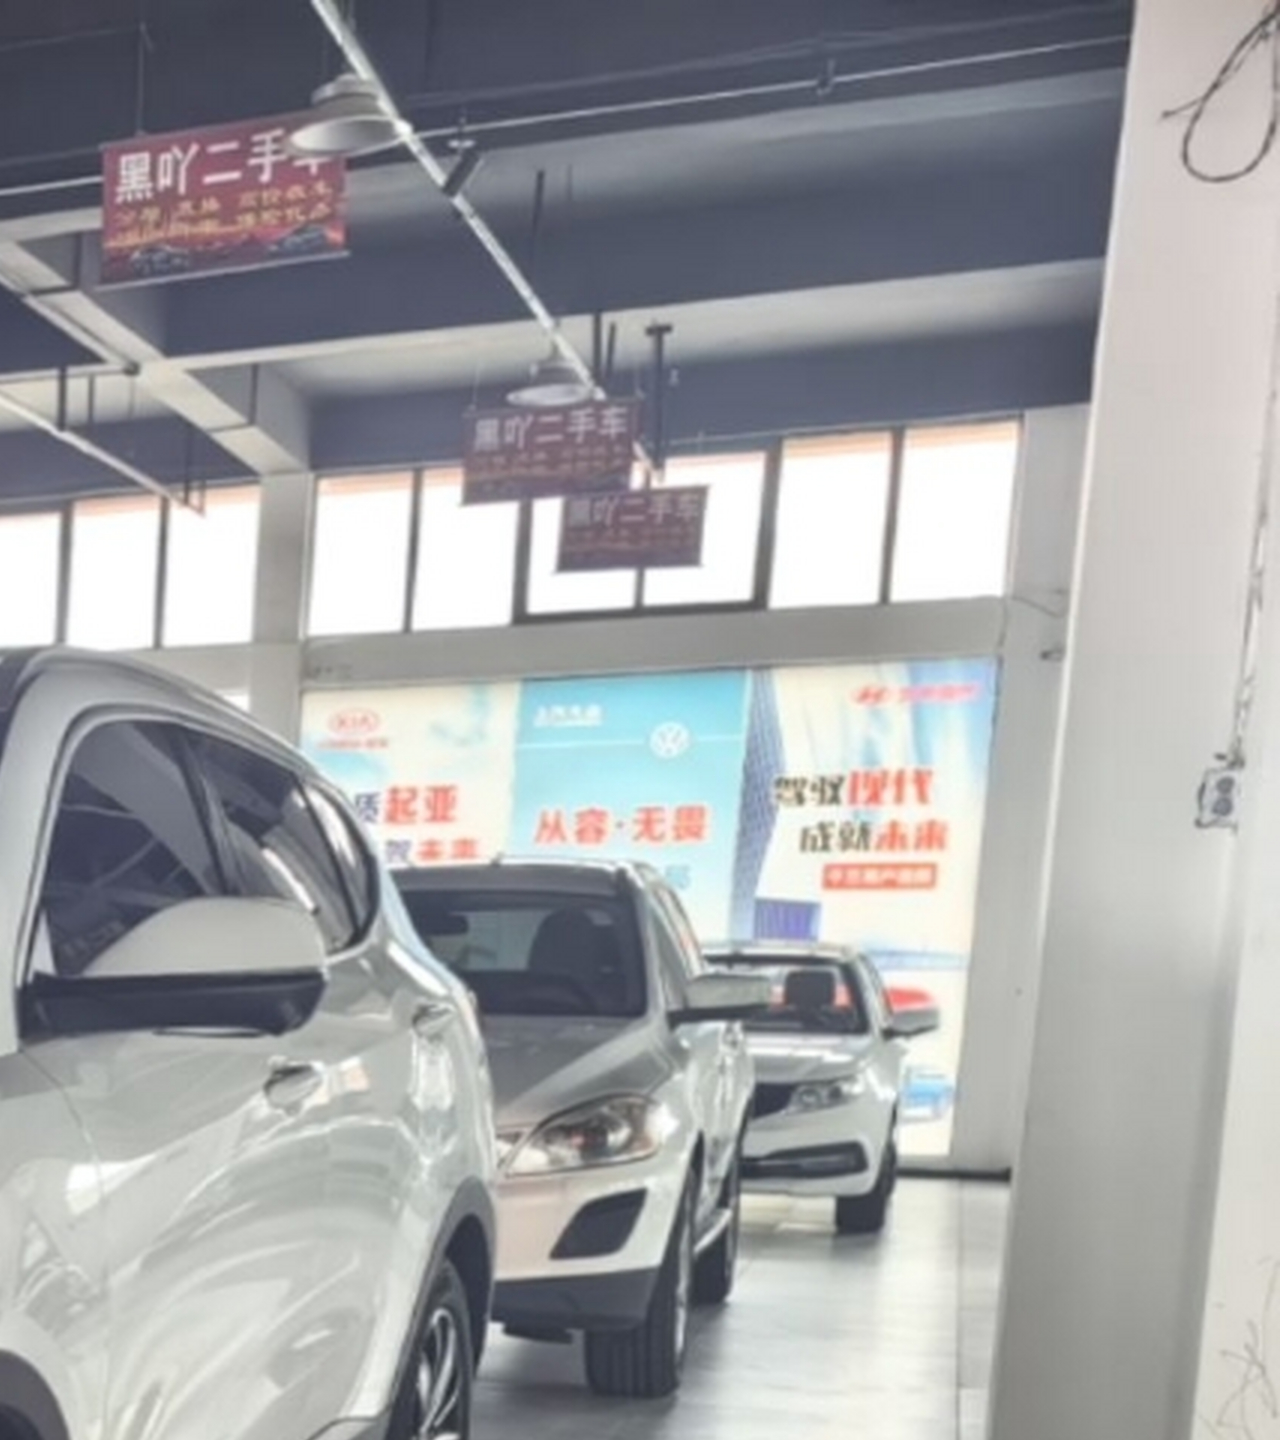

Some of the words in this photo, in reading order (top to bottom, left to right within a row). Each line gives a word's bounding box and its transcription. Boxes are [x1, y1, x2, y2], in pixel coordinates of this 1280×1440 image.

[474, 405, 629, 451] 黑吖二手车
[774, 769, 933, 807] 驾驭现代
[799, 819, 948, 853] 成就未来
